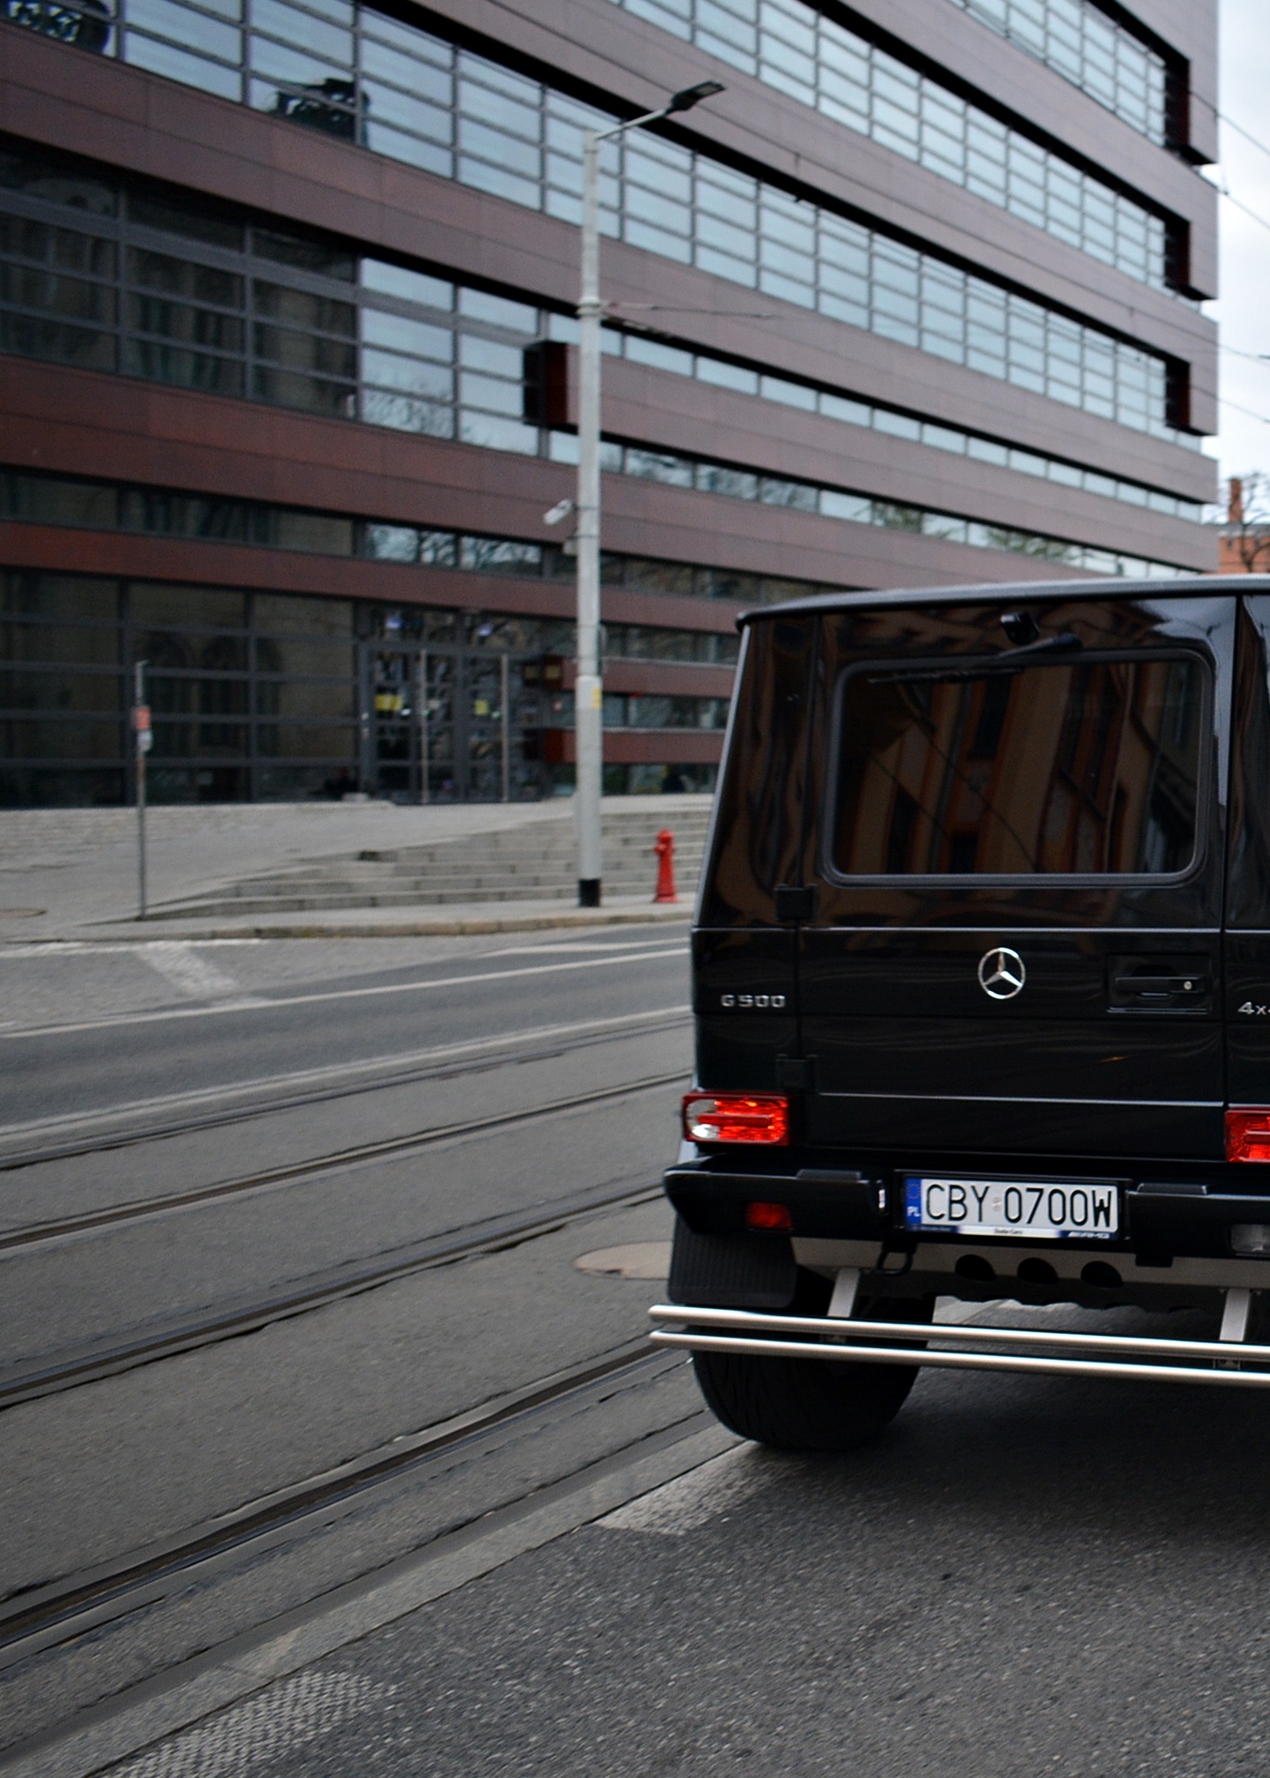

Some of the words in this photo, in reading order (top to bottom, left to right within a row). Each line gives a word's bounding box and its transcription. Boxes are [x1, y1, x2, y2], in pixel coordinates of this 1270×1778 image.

[907, 1206, 922, 1218] PL
[926, 1183, 991, 1223] CBY
[1004, 1187, 1113, 1228] 0700W
